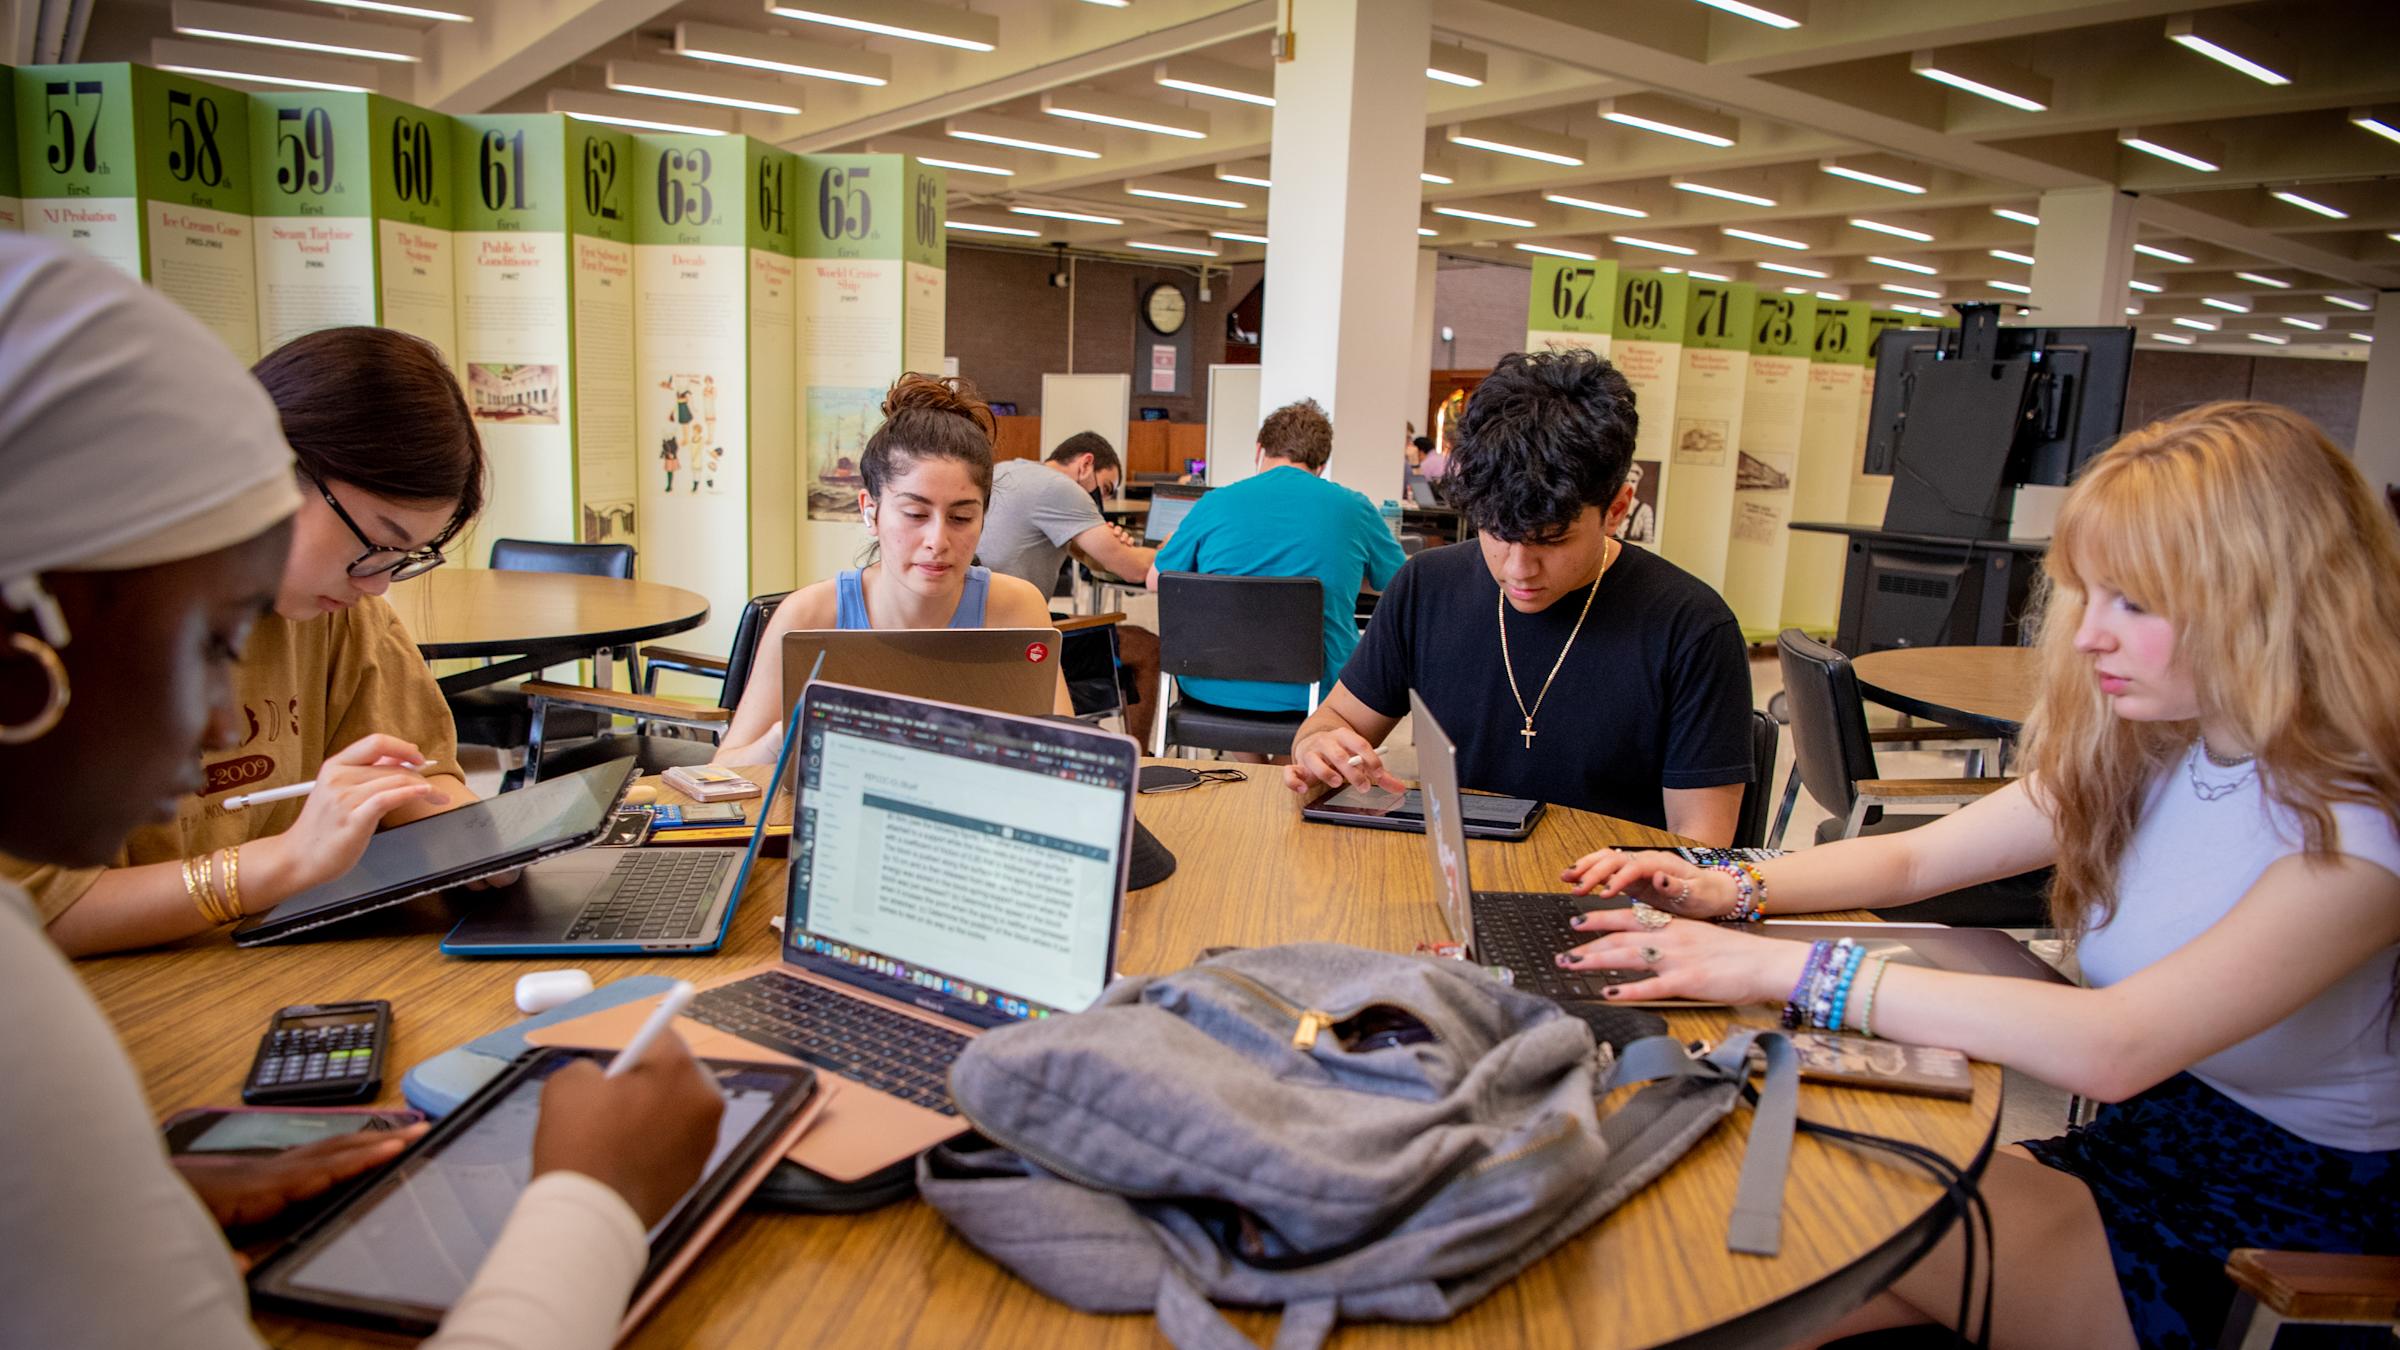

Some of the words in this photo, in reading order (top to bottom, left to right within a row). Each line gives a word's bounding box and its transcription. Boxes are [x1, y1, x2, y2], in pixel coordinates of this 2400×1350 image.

[62, 207, 117, 223] Probation
[180, 215, 215, 233] Cream
[216, 222, 243, 238] Cone
[482, 240, 514, 254] Public
